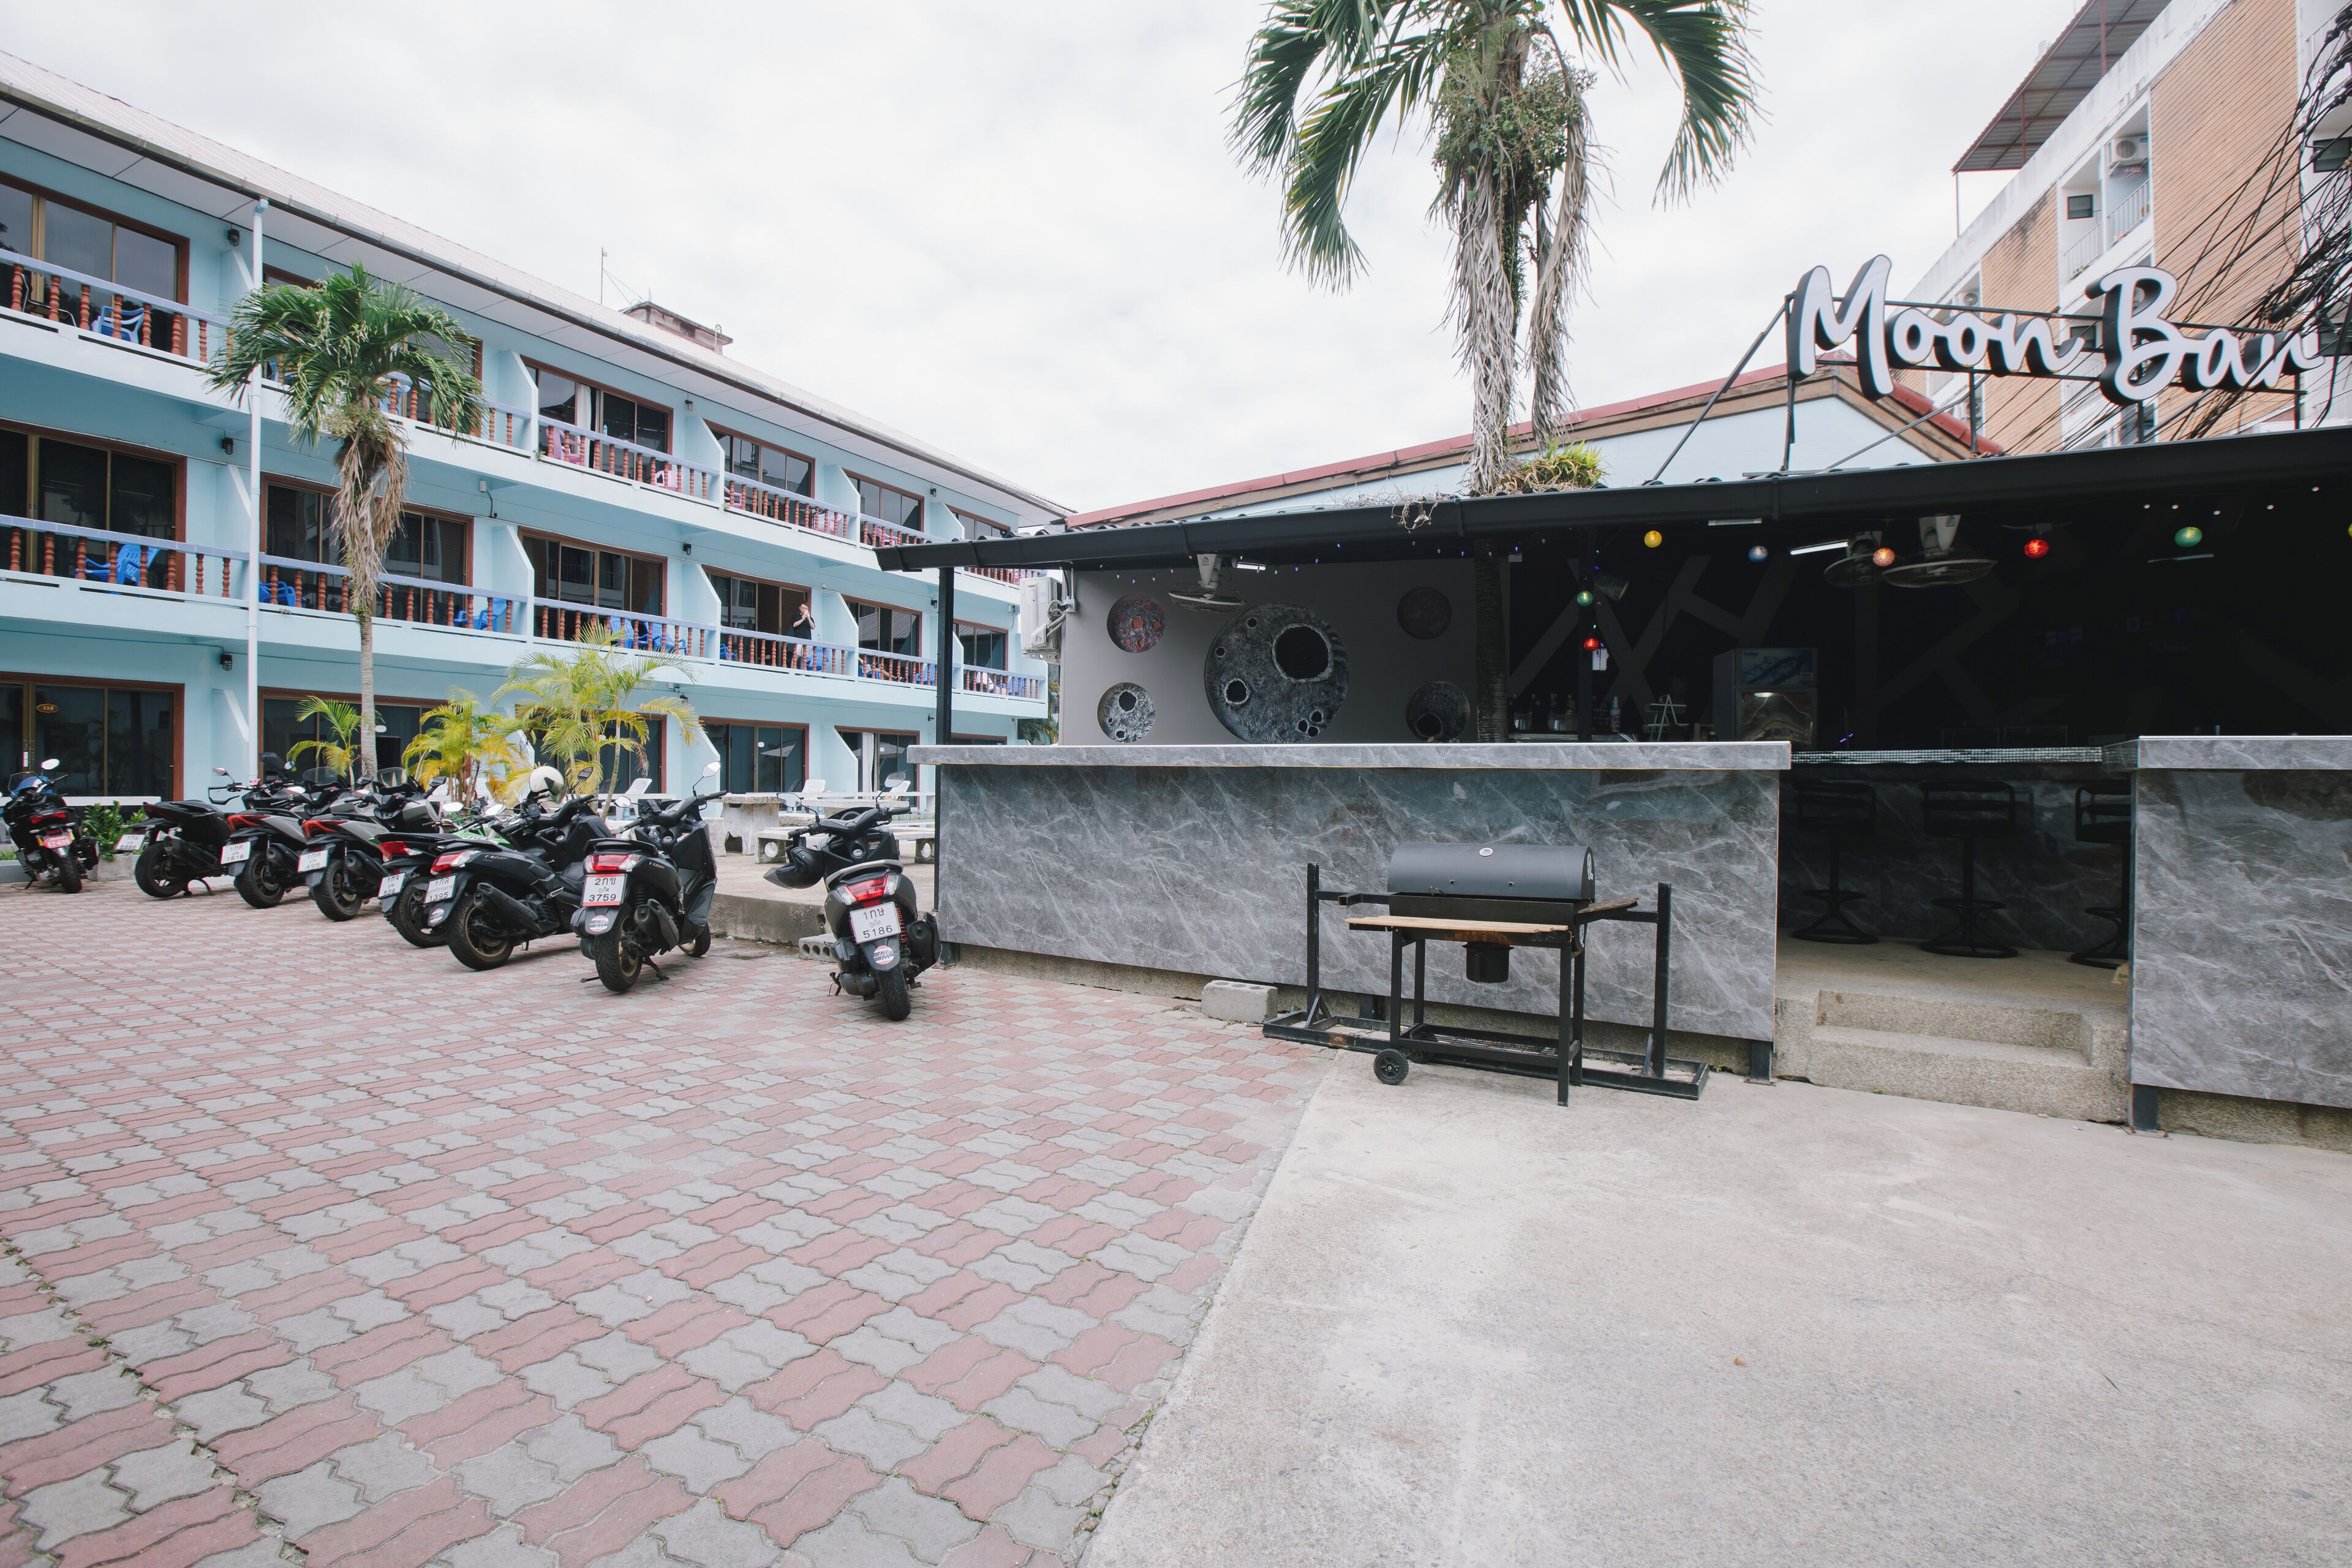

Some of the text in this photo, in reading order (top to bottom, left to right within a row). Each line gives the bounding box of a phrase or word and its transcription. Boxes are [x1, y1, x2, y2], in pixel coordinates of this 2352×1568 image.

[1789, 254, 2325, 405] Moon Bar
[430, 891, 449, 902] 1395
[589, 893, 617, 902] 3759
[862, 925, 892, 938] 5186
